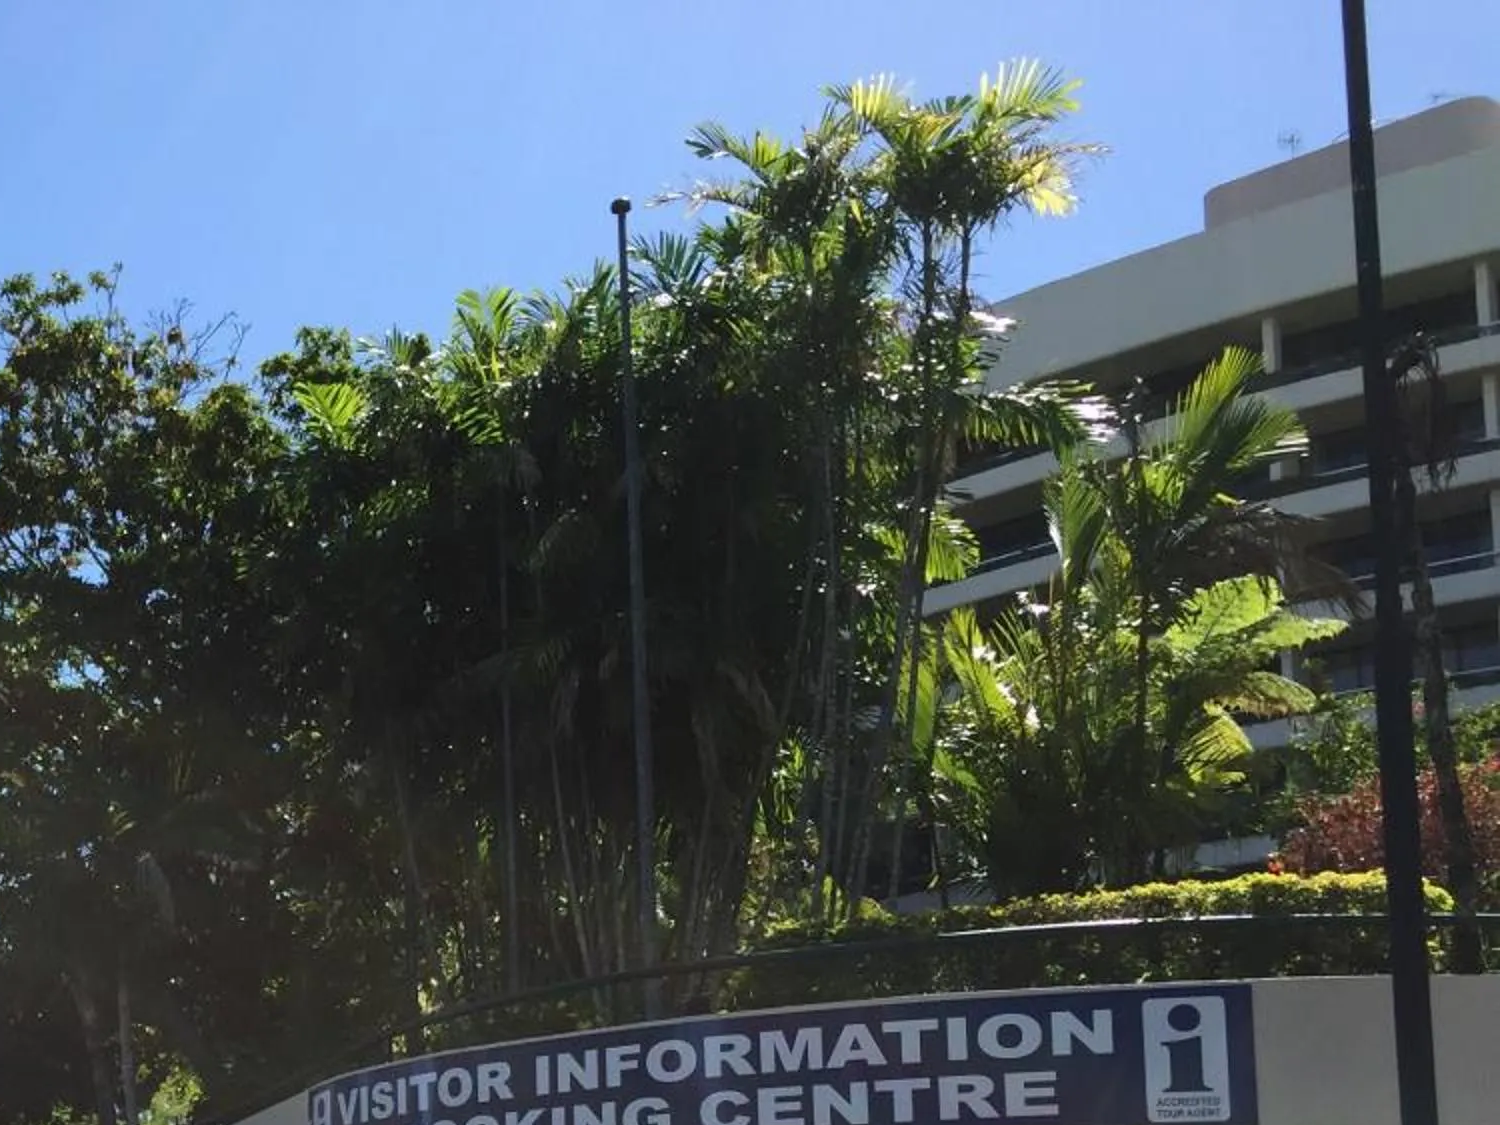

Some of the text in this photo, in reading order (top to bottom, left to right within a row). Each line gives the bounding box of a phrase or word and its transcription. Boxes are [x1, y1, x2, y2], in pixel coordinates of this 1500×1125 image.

[534, 1008, 1115, 1096] INFORMATION
[1155, 1095, 1222, 1107] ACCREDITED
[1155, 1107, 1221, 1119] TOUR AGENT
